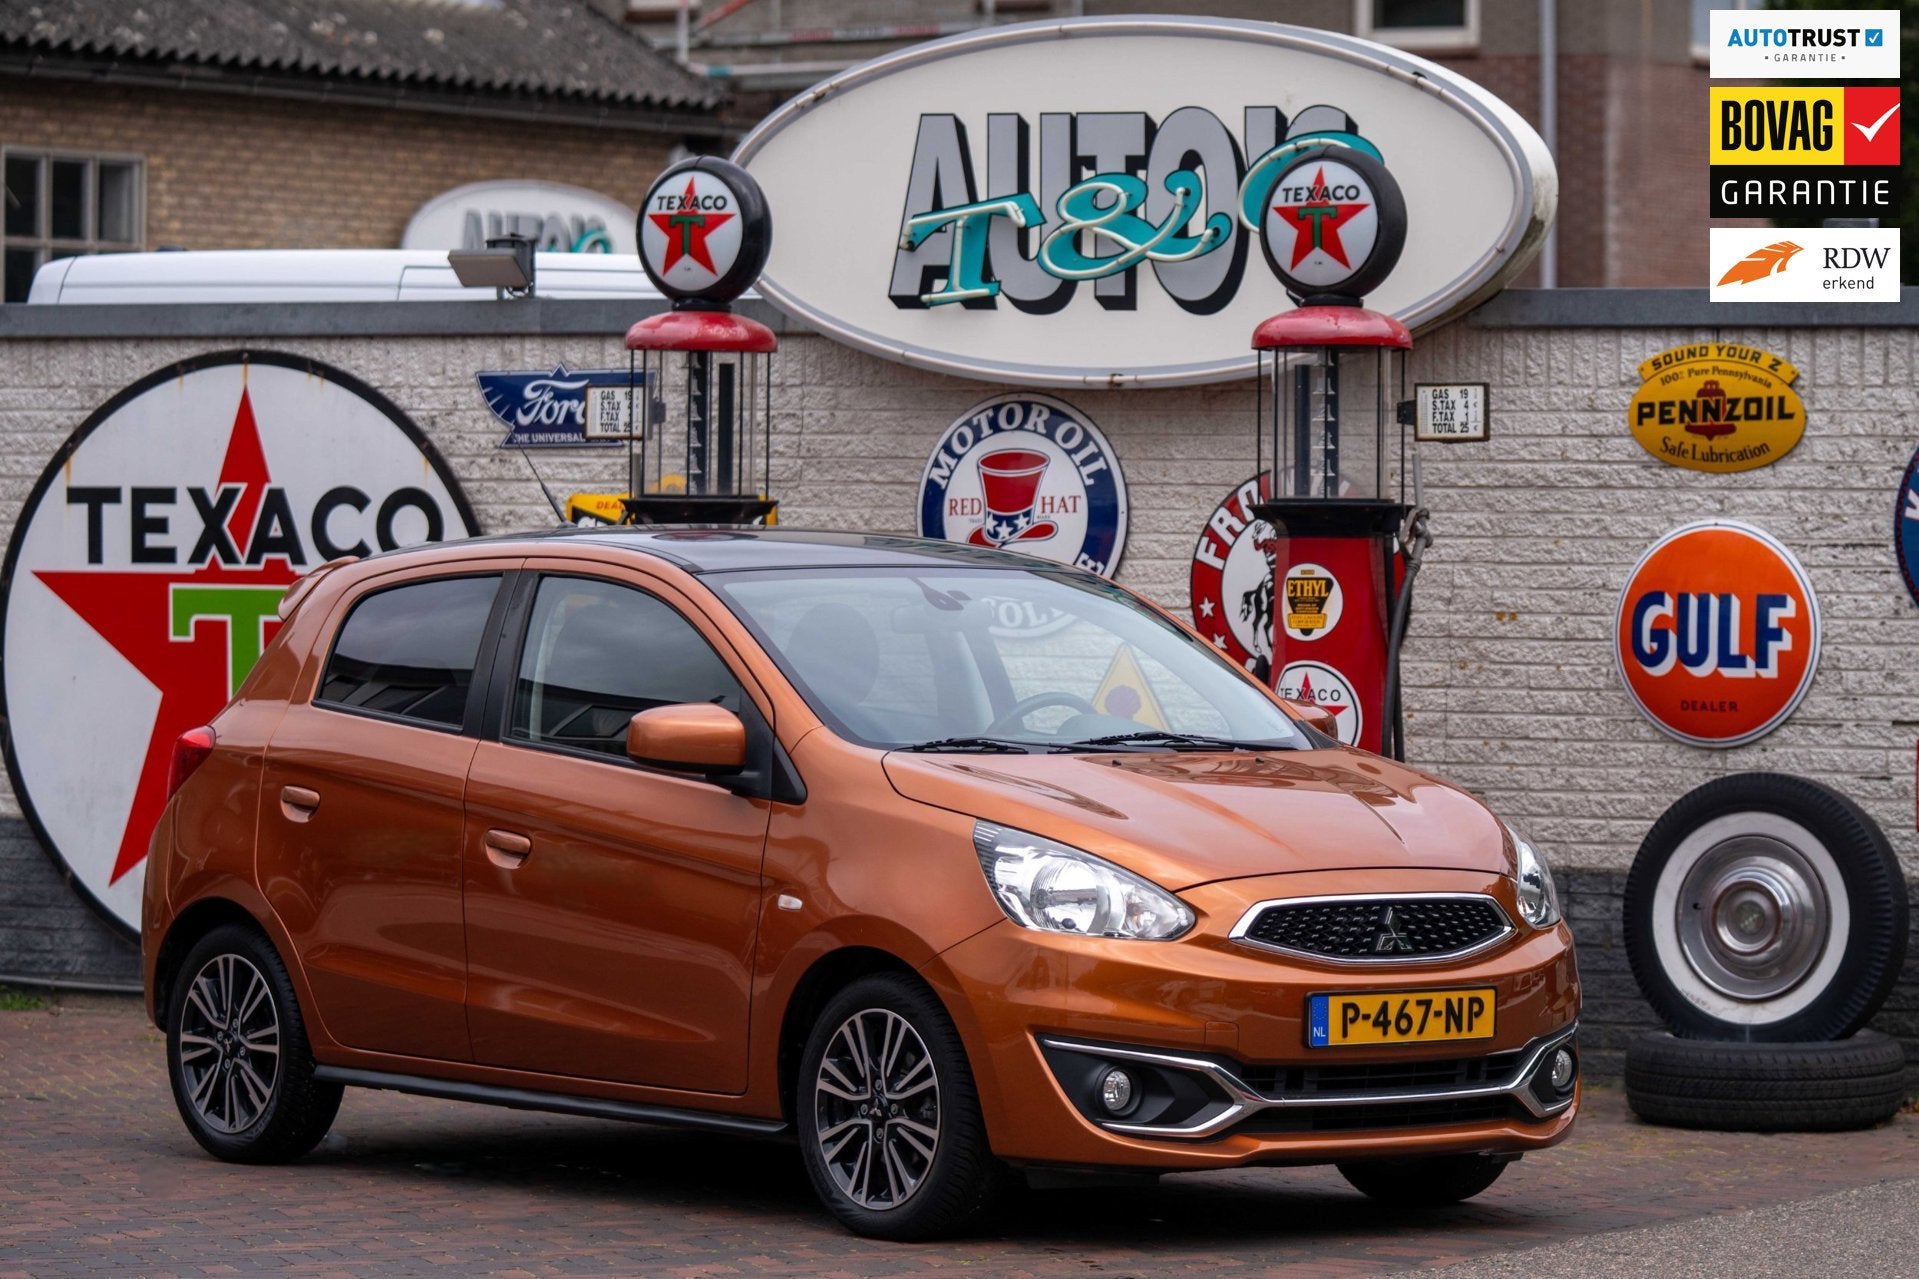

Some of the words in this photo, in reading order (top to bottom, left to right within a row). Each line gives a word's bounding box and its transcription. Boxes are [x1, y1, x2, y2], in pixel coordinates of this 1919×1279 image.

[657, 194, 728, 211] TEXACO
[1282, 184, 1361, 203] TEXACO
[888, 104, 1359, 316] AUTO'
[1651, 346, 1709, 371] SOUND
[1716, 345, 1762, 364] YOUR
[1767, 358, 1783, 372] Z
[1687, 367, 1711, 379] Pure
[1711, 366, 1773, 389] Pennsylvania
[516, 379, 590, 427] For
[600, 390, 616, 401] GAS
[1432, 388, 1449, 399] GAS
[1460, 388, 1469, 399] 19
[600, 401, 621, 411] S.TAX
[1432, 400, 1456, 411] S.TAX
[1464, 400, 1469, 411] 4
[1637, 396, 1795, 426] PENNZOIL
[1432, 411, 1455, 422] F.TAX
[600, 422, 622, 433] TOTAL
[1432, 423, 1457, 434] TOTAL
[1460, 422, 1470, 433] 25
[532, 432, 586, 443] UNIVERSAL
[929, 402, 1051, 490] MOTOR
[1054, 420, 1108, 487] OIL
[1659, 436, 1690, 459] Safe
[1691, 442, 1771, 464] Lubrication
[949, 497, 983, 517] RED
[1040, 495, 1082, 514] HAT
[66, 485, 445, 567] TEXACO
[1287, 580, 1329, 597] ETHYL
[1631, 590, 1797, 679] GULF
[1680, 700, 1739, 713] DEALER
[1313, 1026, 1326, 1037] NL
[1341, 996, 1485, 1039] P-467-NP
